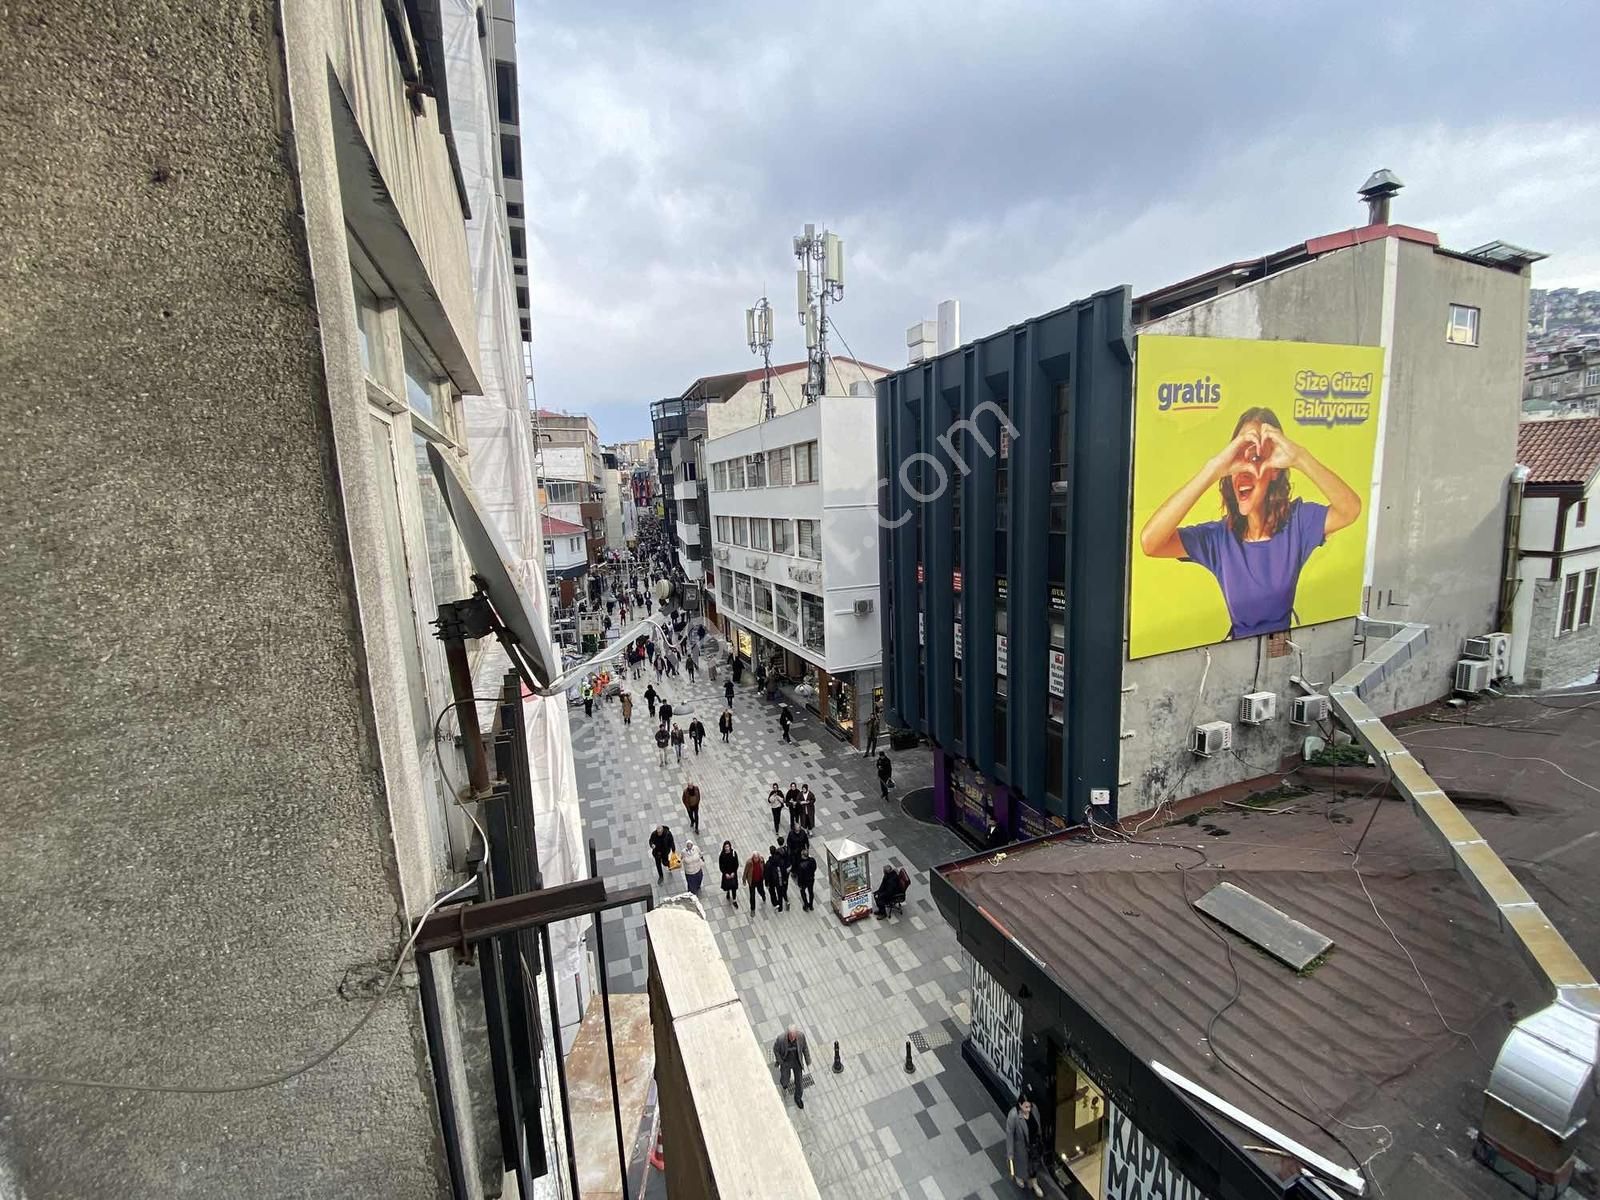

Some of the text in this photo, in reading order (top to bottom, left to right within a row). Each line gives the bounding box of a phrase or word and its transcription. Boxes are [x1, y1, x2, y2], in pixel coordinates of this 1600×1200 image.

[1157, 376, 1221, 411] gratis
[1295, 370, 1372, 398] Size Güzel
[1293, 399, 1369, 427] Bakıyoruz
